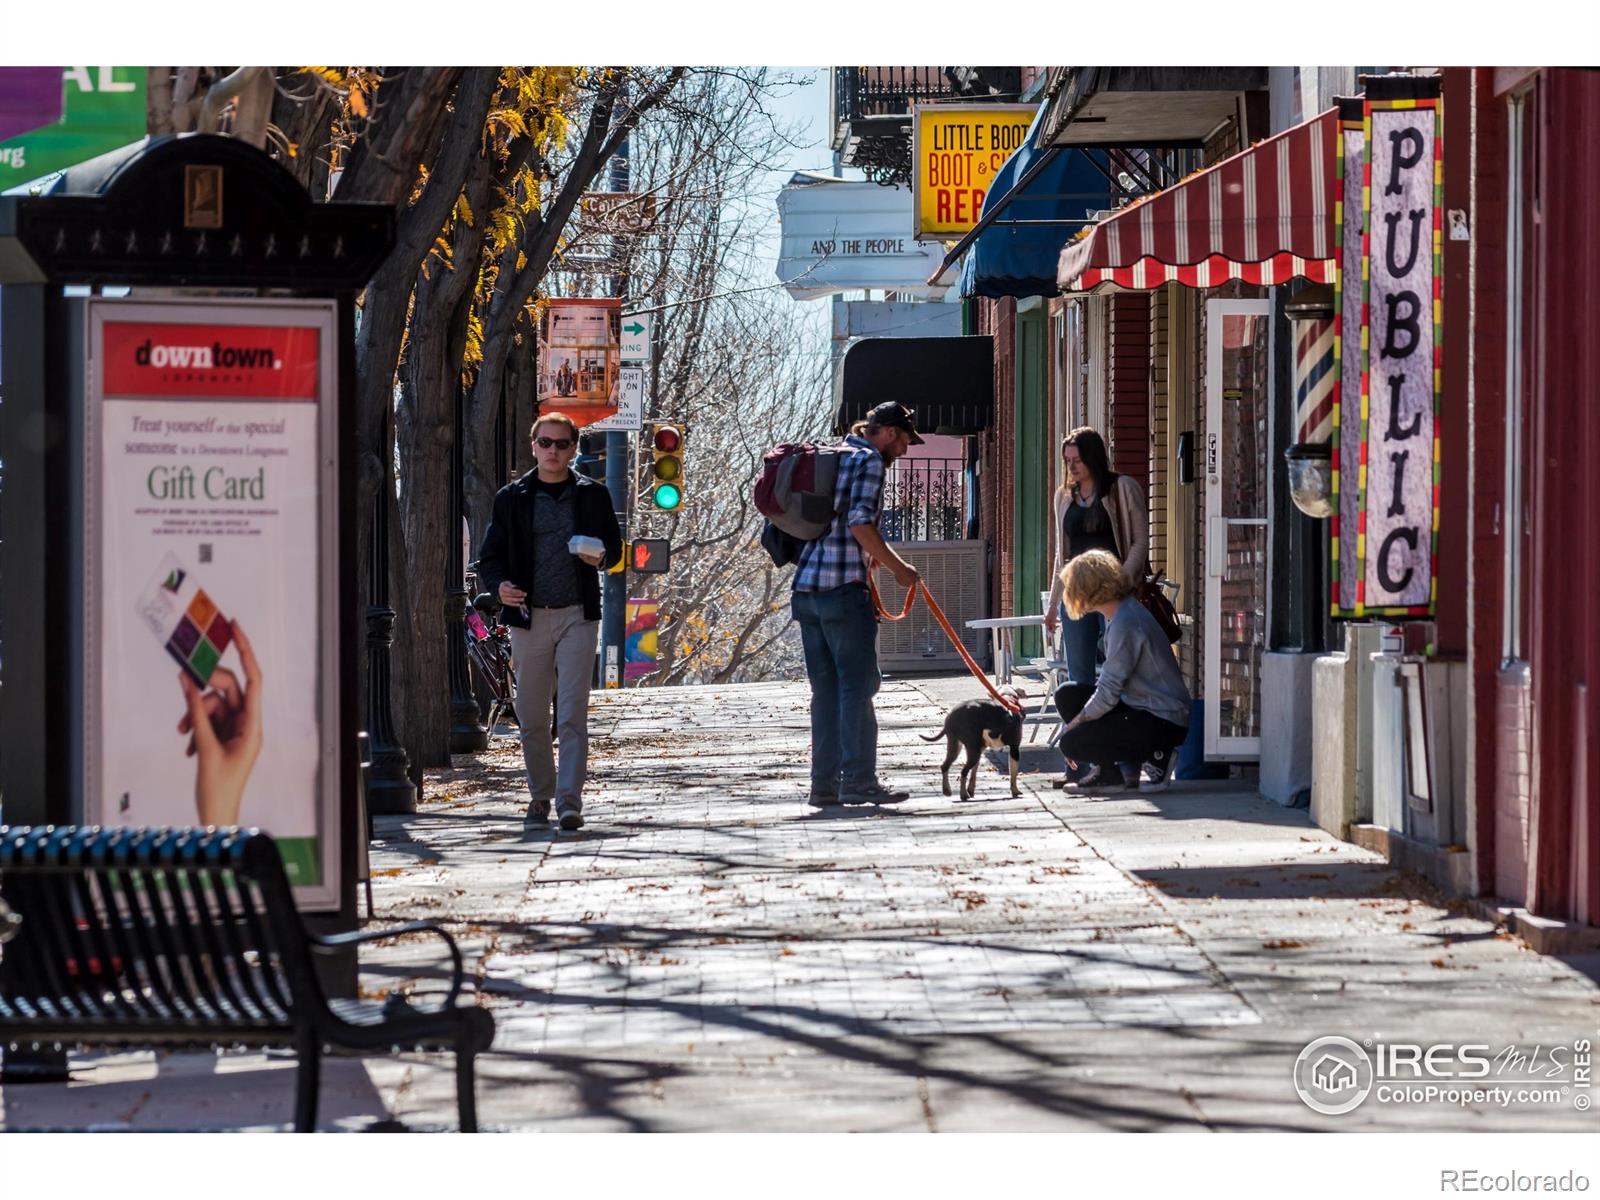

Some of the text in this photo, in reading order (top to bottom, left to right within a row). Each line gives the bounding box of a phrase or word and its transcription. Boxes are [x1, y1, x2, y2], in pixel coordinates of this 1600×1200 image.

[934, 124, 984, 150] LITTLE
[929, 153, 973, 187] BOOT
[978, 162, 987, 174] &
[811, 239, 904, 254] AND THE PEOPLE
[135, 340, 282, 369] downtown.
[1377, 126, 1425, 593] PUBLIC
[131, 416, 162, 432] Treat
[164, 417, 216, 437] yourself
[244, 418, 286, 437] special
[146, 466, 265, 500] Gift Card
